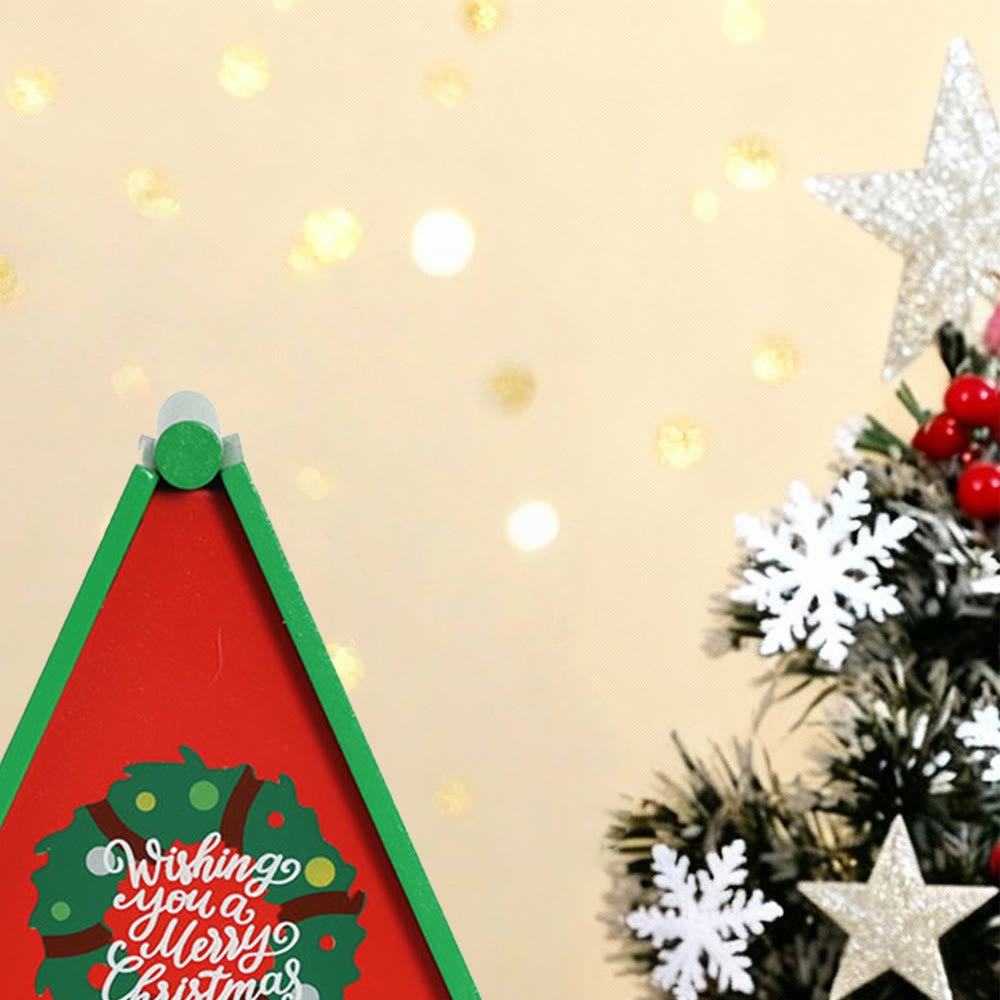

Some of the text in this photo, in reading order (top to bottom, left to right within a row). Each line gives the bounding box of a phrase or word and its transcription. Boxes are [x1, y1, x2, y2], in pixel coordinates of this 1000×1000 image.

[103, 831, 301, 897] Wishing
[113, 886, 256, 941] you a
[140, 917, 300, 973] Merry
